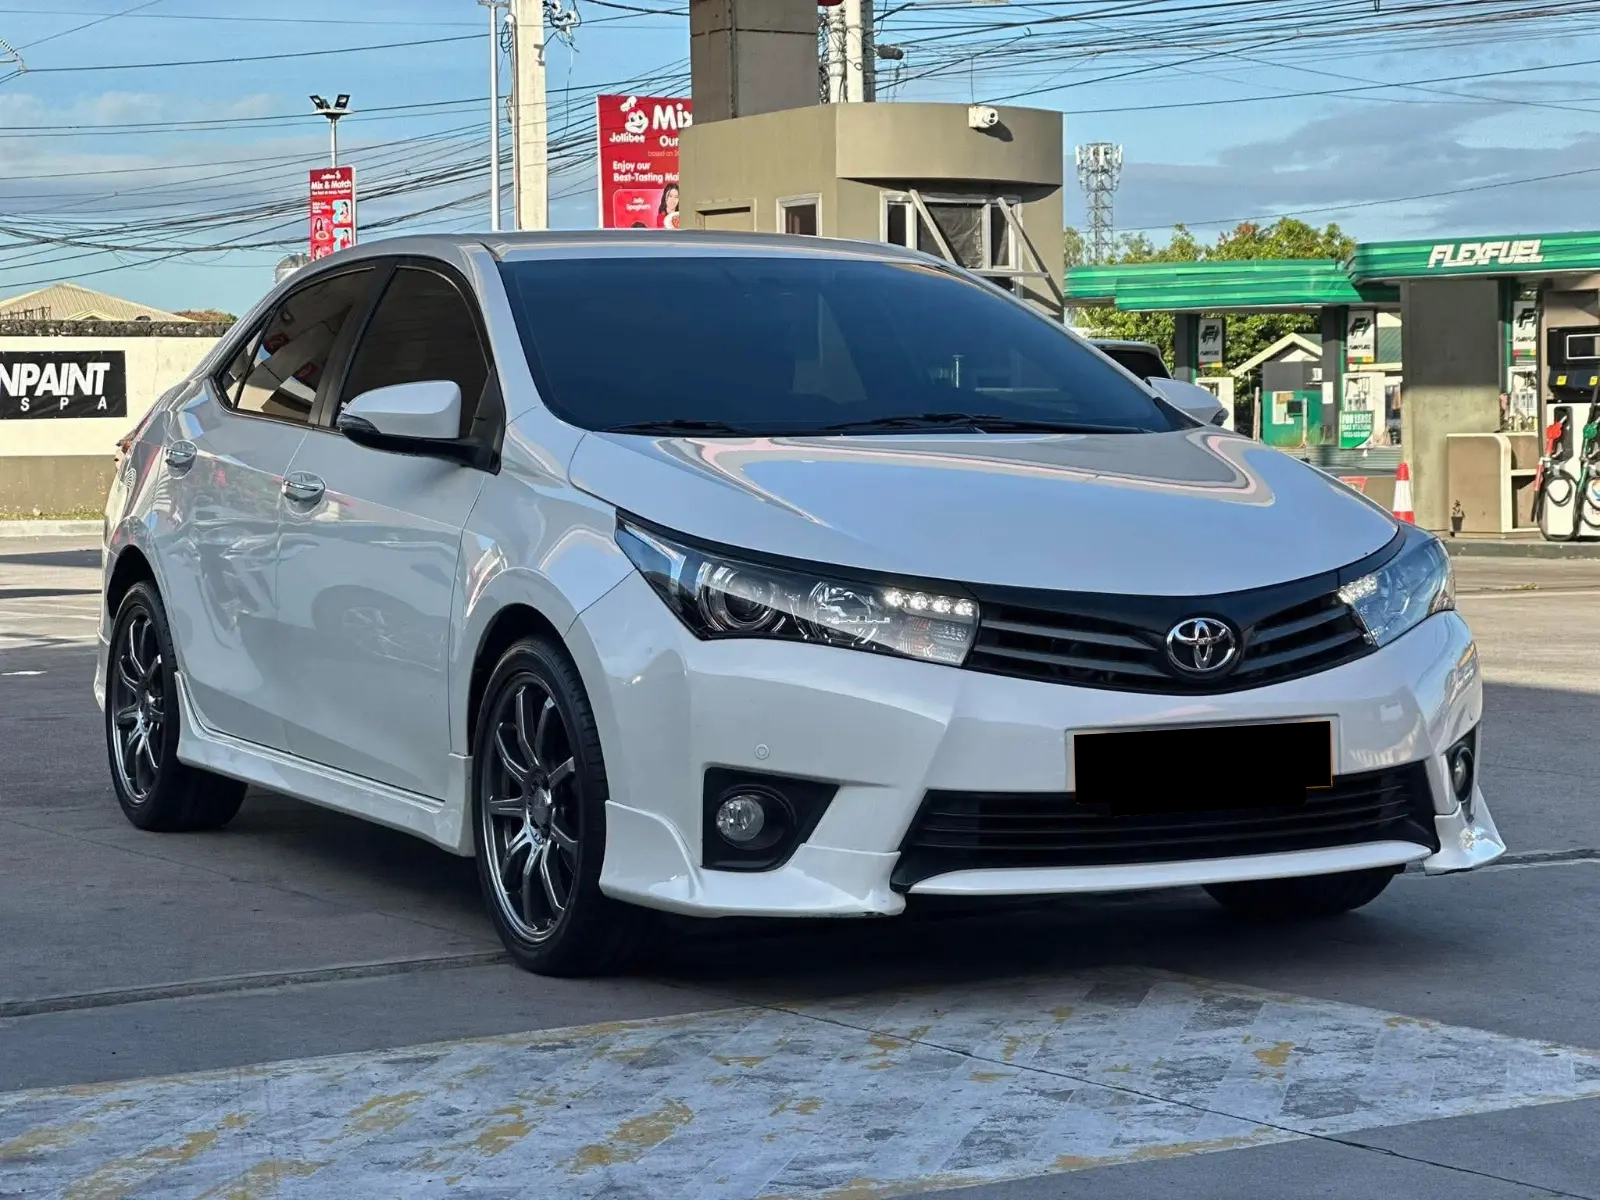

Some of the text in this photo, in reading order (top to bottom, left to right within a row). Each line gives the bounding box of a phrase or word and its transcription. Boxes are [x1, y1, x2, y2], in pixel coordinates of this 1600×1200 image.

[609, 132, 645, 143] Jollibee
[659, 135, 679, 147] Our
[612, 160, 651, 172] Enjoy our
[613, 172, 663, 184] Best-Tasting
[311, 179, 351, 190] Mix & Match
[1427, 239, 1544, 269] FLEXFUEL
[0, 362, 111, 397] NPAINT
